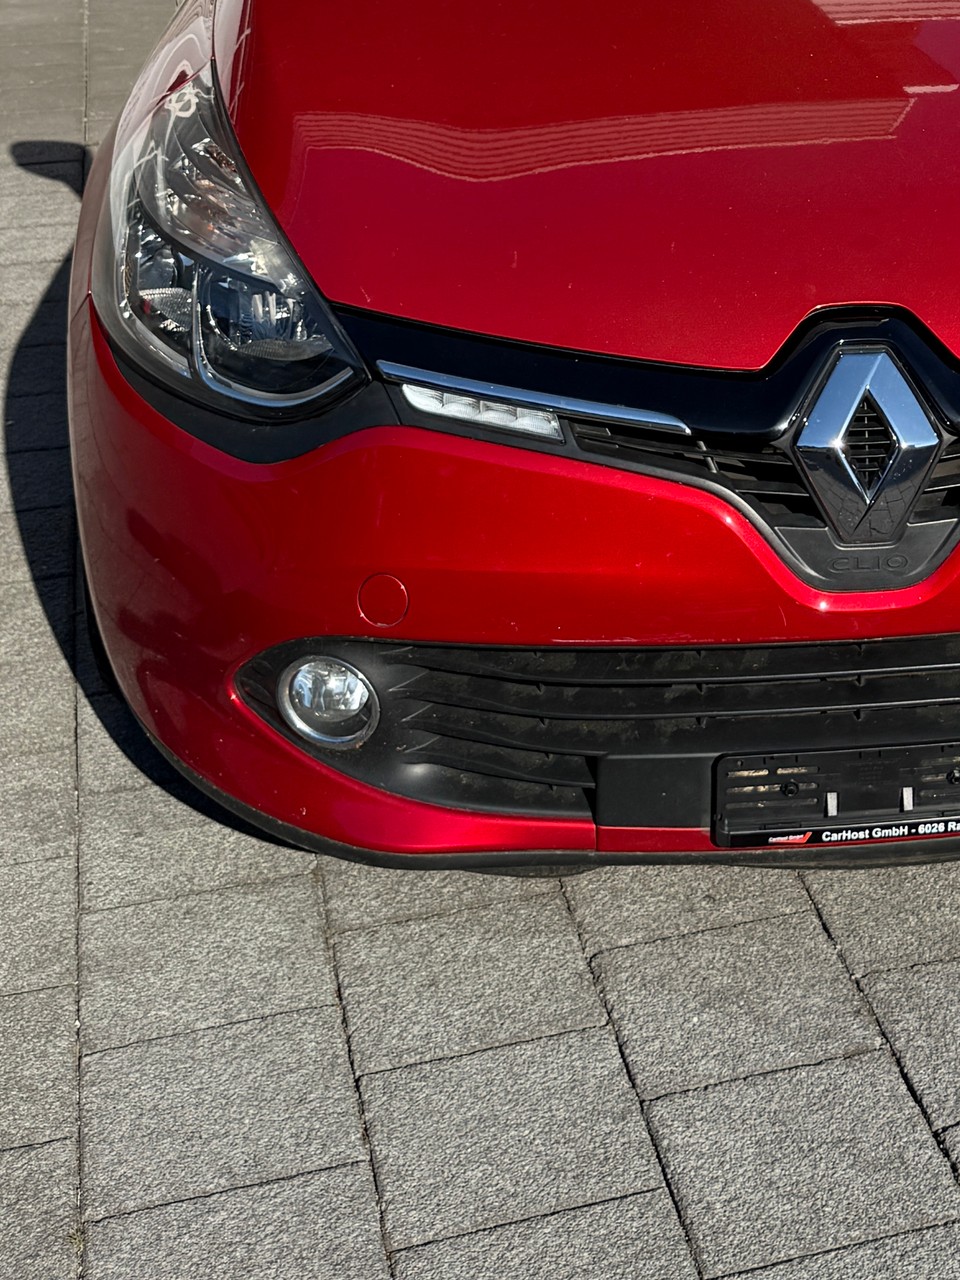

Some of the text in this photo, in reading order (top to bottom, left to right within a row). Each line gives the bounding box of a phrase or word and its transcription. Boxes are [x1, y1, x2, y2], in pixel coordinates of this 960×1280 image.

[830, 554, 908, 573] CLIO
[822, 830, 870, 841] CarHost
[872, 825, 908, 838] GmbH
[918, 823, 945, 834] 6026
